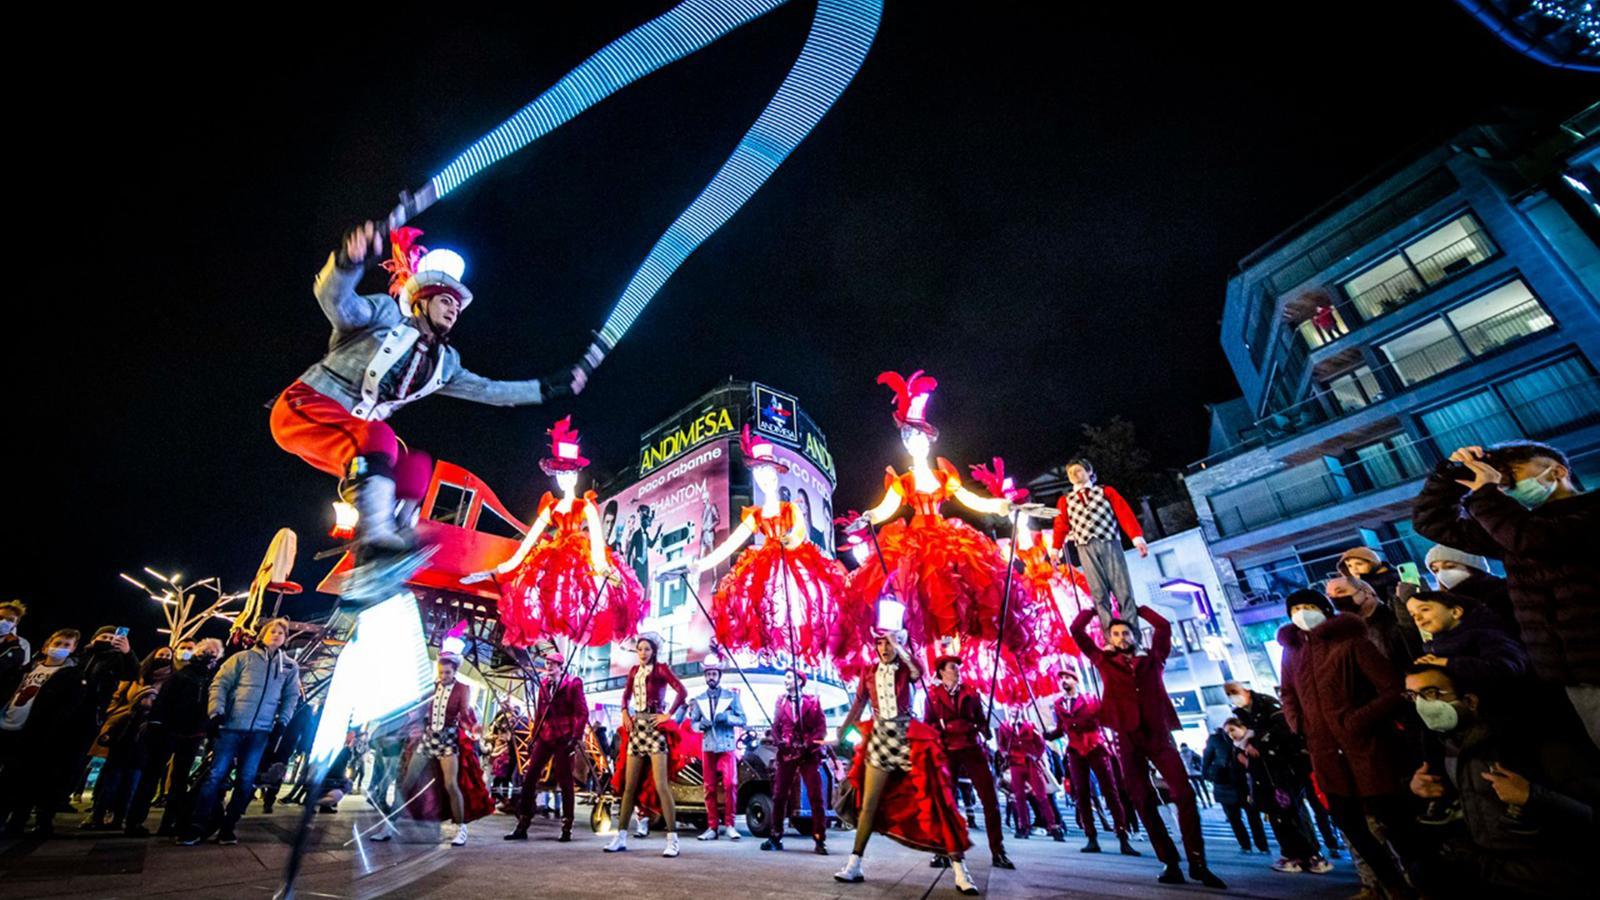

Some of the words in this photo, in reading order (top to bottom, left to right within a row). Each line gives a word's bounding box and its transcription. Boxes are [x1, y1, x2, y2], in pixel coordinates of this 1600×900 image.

[640, 408, 734, 474] ANDIMESA
[760, 420, 795, 438] ANDIMESA
[638, 475, 665, 499] paco
[667, 447, 722, 481] rabanne
[649, 478, 707, 512] PHANTOM
[1170, 697, 1185, 707] LY
